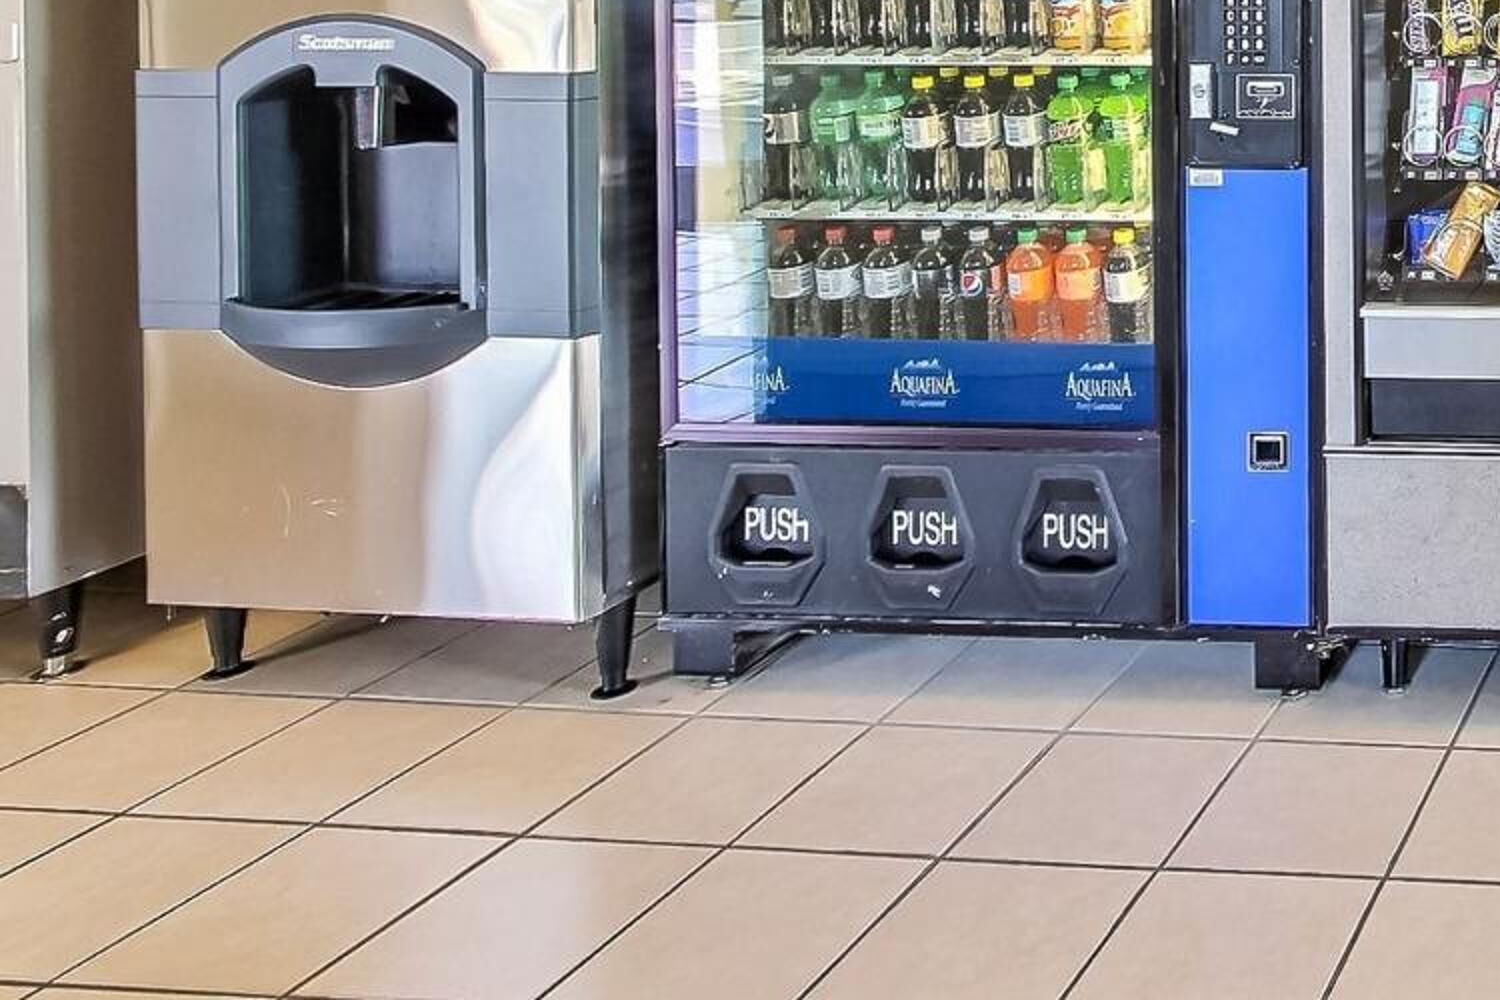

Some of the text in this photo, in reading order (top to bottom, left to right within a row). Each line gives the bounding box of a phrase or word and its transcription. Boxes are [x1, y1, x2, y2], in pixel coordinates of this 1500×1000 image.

[298, 35, 395, 51] Scotsman
[890, 367, 958, 397] AQUAFINA
[1065, 372, 1133, 400] AQUAFINA
[743, 506, 809, 542] PUSH
[892, 510, 957, 545] PUSH
[1043, 513, 1109, 549] PUSH
